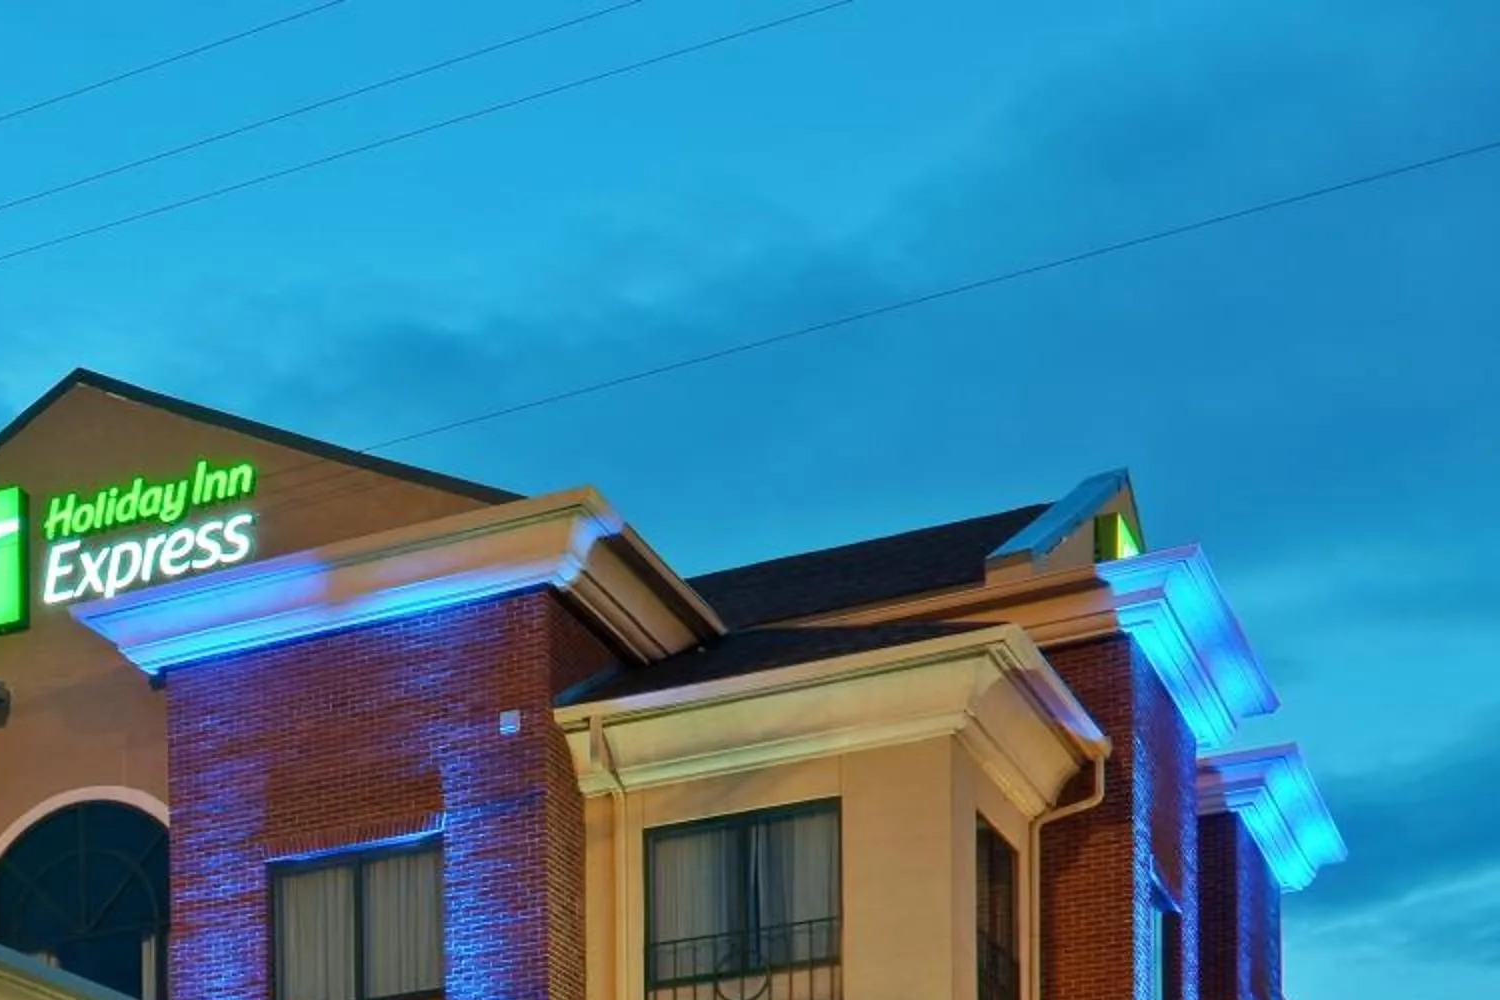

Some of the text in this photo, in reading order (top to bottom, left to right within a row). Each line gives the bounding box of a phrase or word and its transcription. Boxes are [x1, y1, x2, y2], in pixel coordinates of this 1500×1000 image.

[43, 460, 252, 539] Holiday Inn
[43, 513, 253, 604] Express
